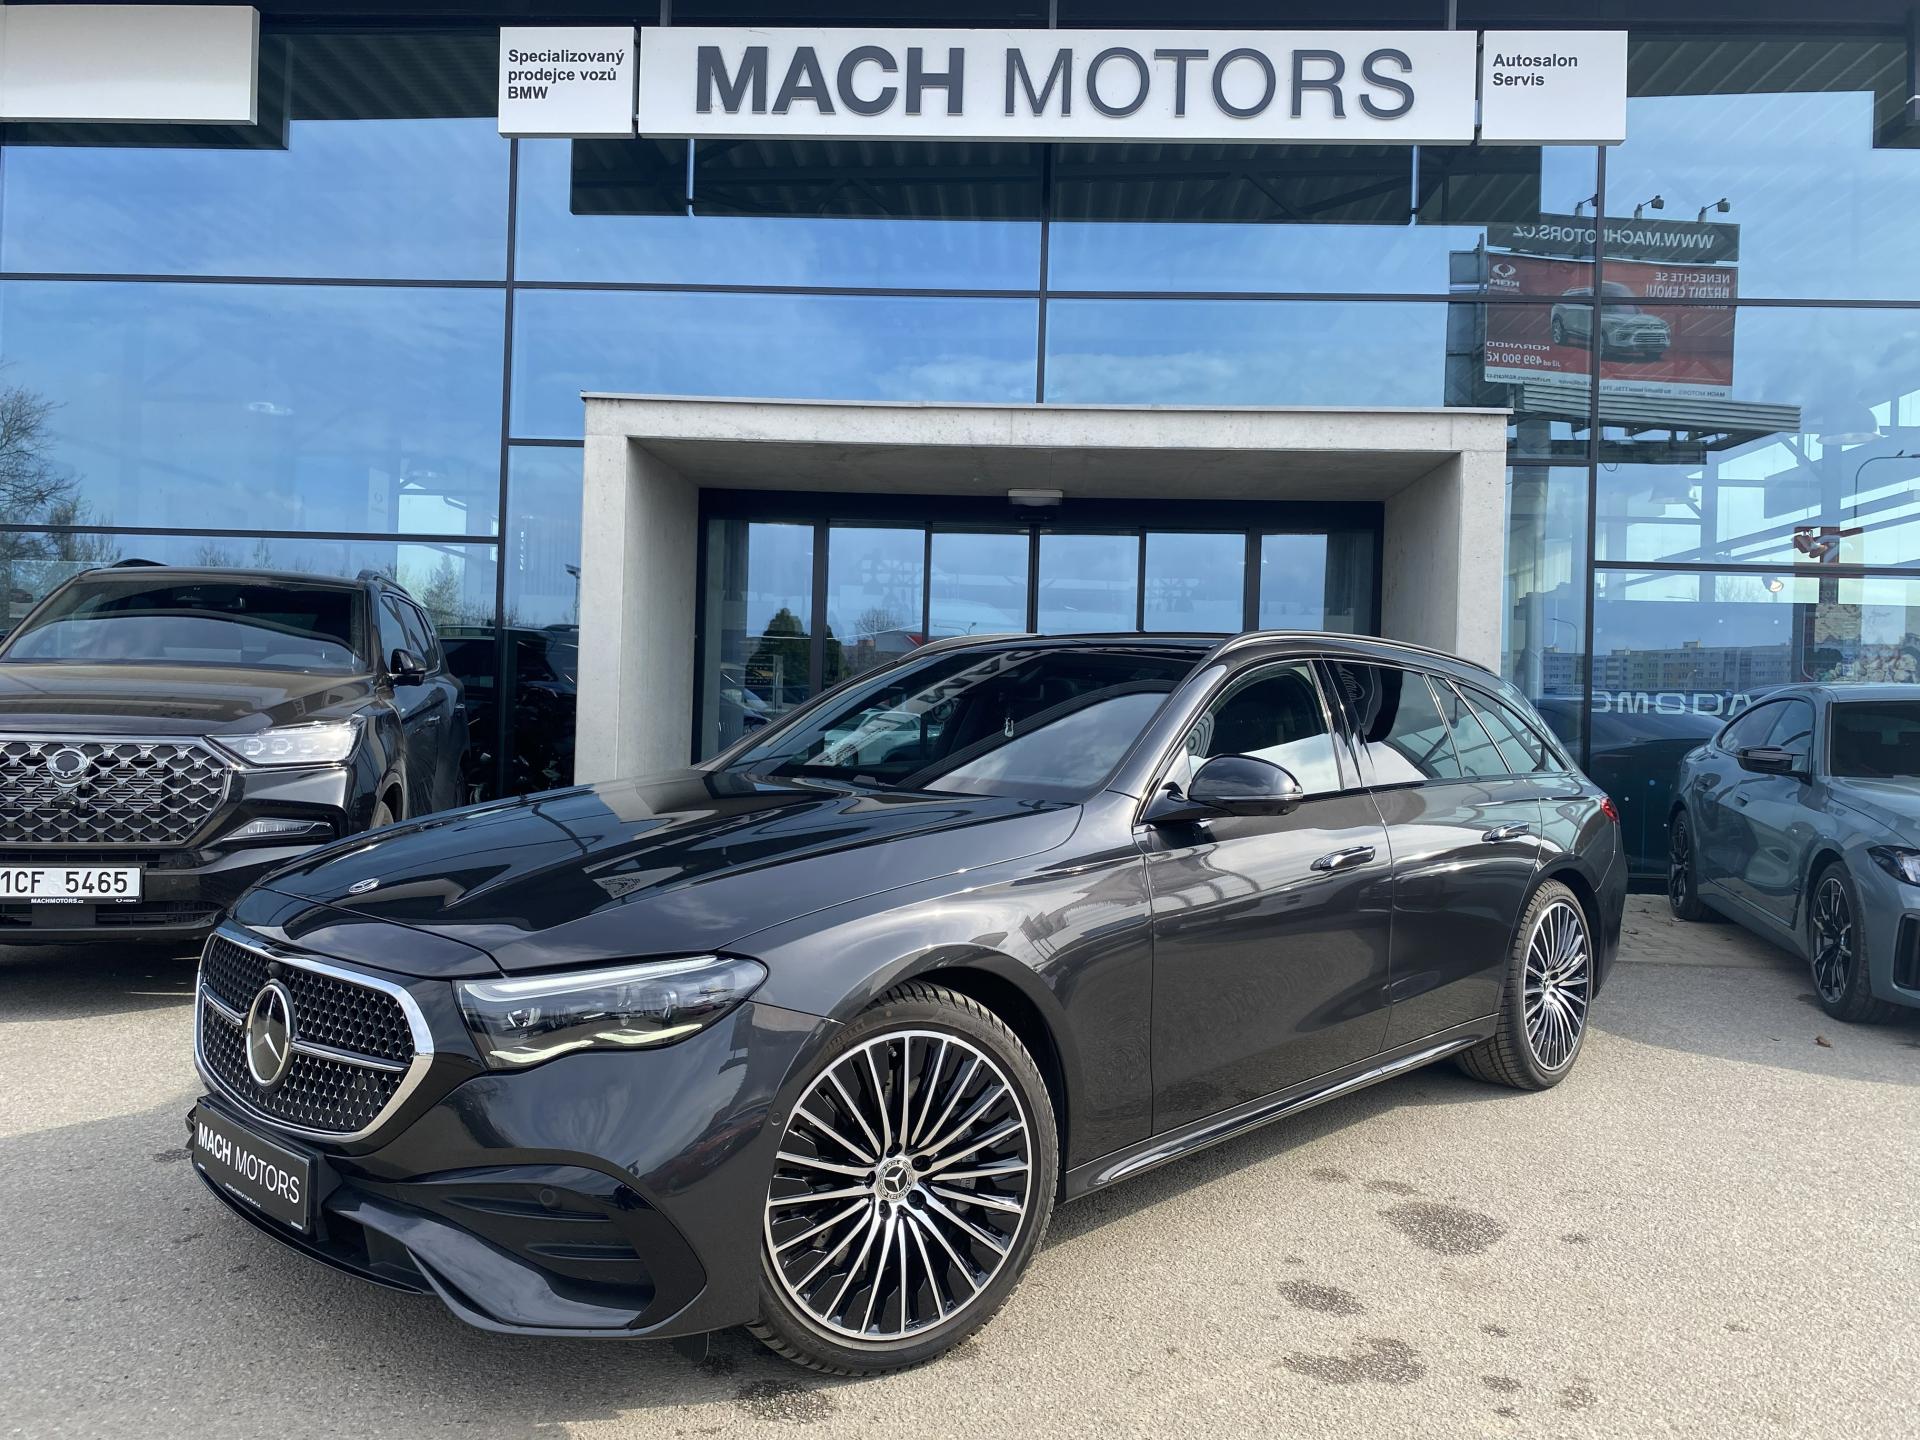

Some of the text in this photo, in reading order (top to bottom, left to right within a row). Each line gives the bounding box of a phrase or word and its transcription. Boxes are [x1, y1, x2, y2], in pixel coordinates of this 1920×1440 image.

[507, 48, 625, 66] Specializovaný
[1492, 53, 1578, 67] Autosalon
[507, 67, 617, 84] prodejce vozů
[696, 45, 1415, 120] MACH MOTORS
[1492, 72, 1545, 86] Servis
[507, 86, 549, 99] BMW
[0, 870, 128, 894] 1CF 5465
[198, 1121, 232, 1166] MACH
[234, 1145, 300, 1204] MOTORS
